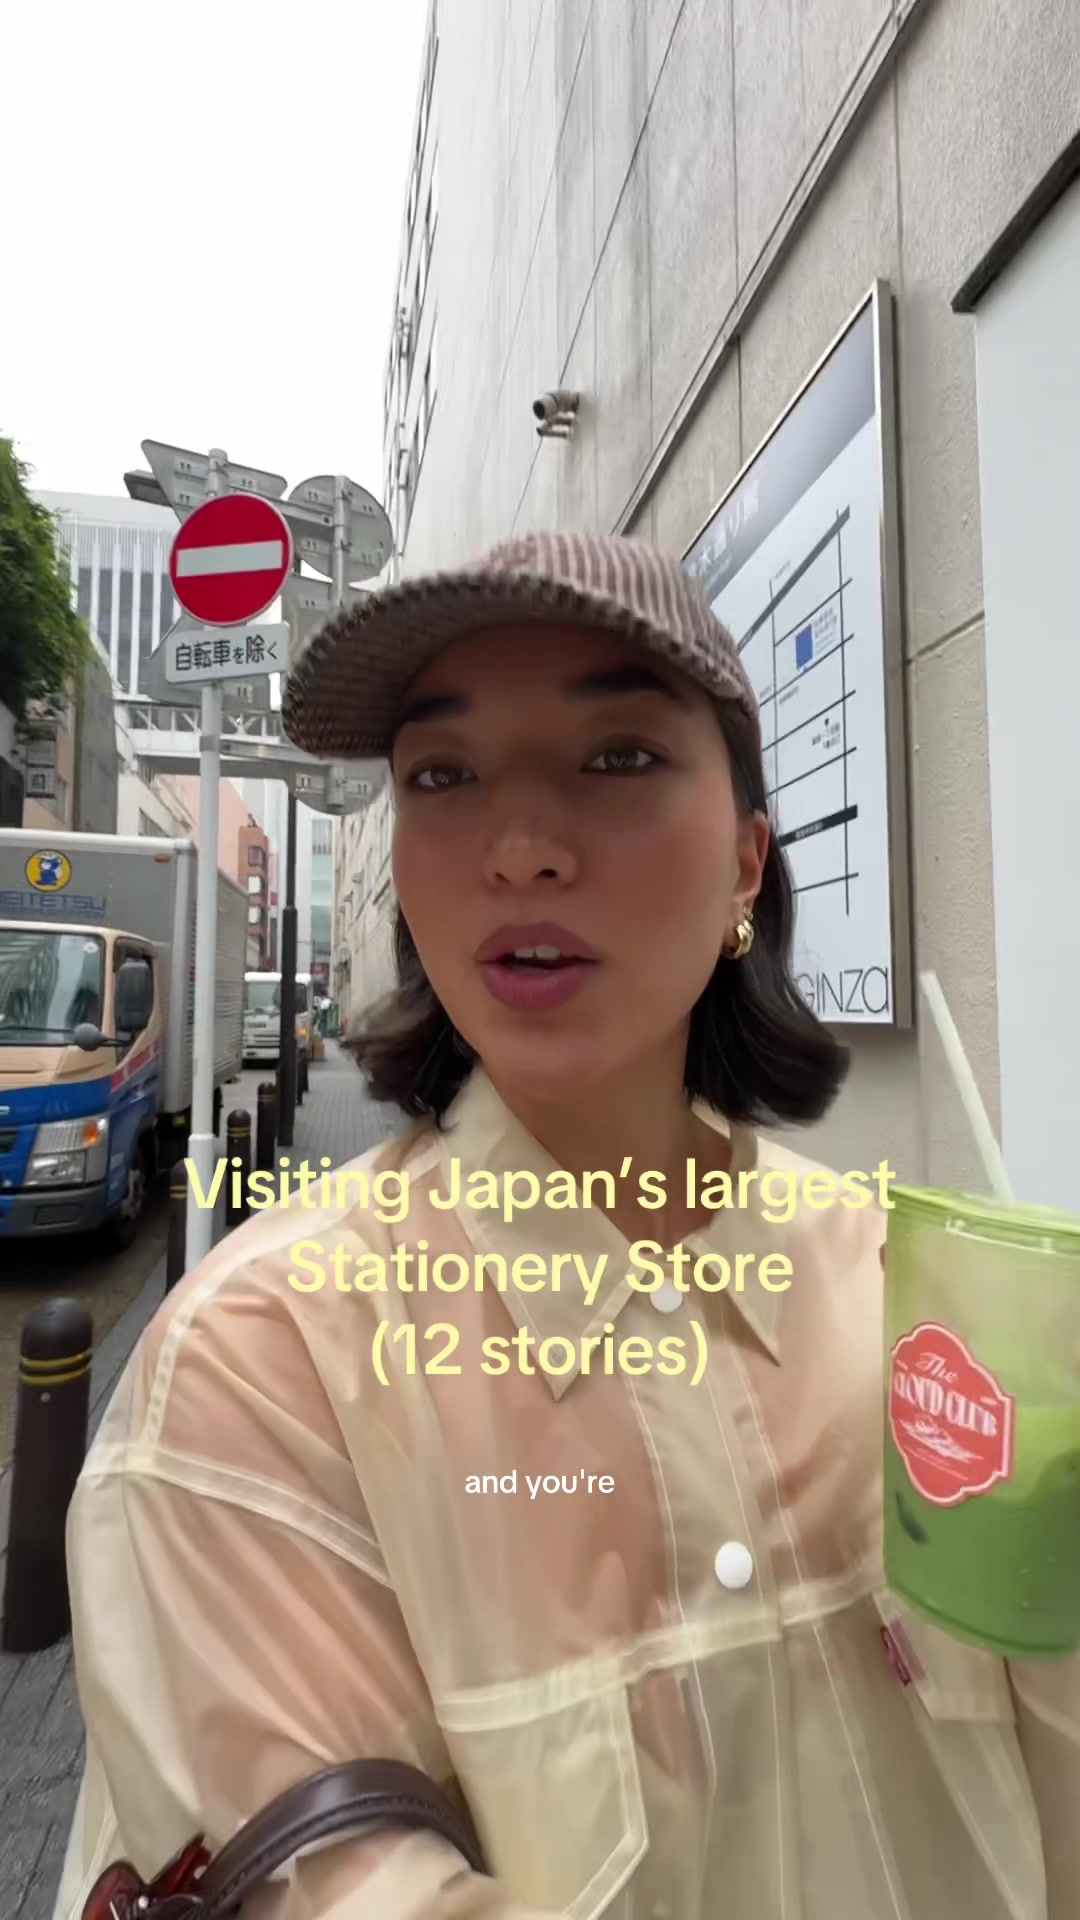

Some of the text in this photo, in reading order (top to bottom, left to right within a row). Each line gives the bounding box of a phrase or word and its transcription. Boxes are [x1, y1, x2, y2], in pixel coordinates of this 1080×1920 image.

[175, 633, 277, 671] 自転車を除く
[915, 1352, 959, 1384] The
[946, 1390, 998, 1437] CLUB
